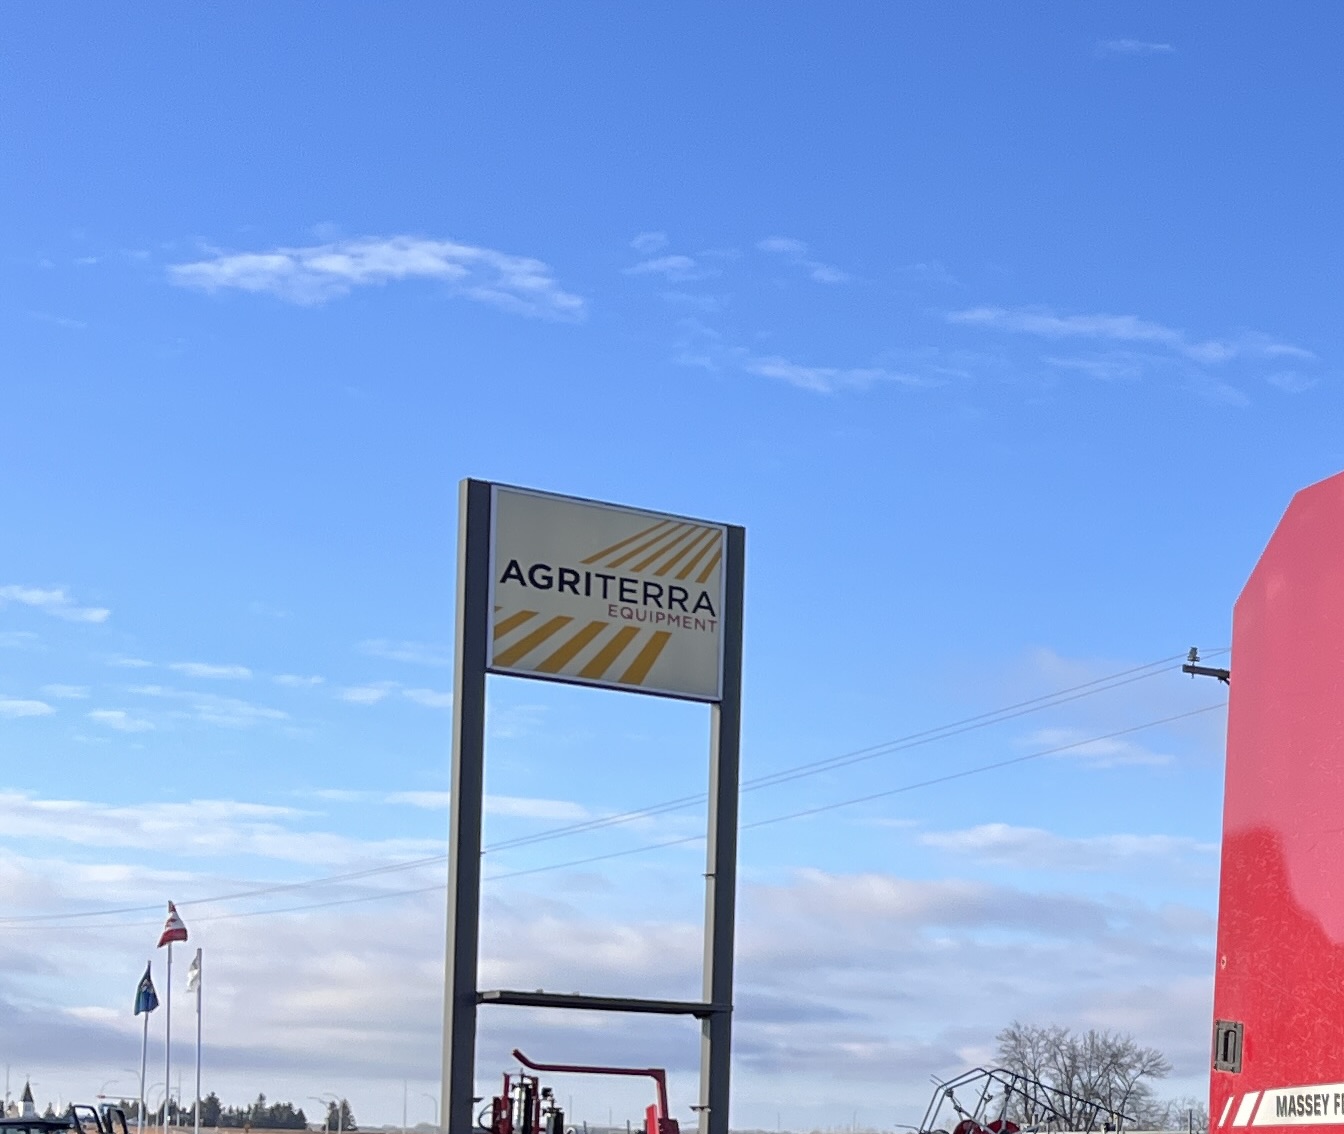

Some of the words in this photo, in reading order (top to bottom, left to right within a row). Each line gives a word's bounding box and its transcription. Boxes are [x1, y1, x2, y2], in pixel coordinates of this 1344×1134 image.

[499, 559, 716, 617] AGRITERRA
[607, 604, 718, 633] EQUIPMENT
[1276, 1093, 1330, 1117] MASSEY
